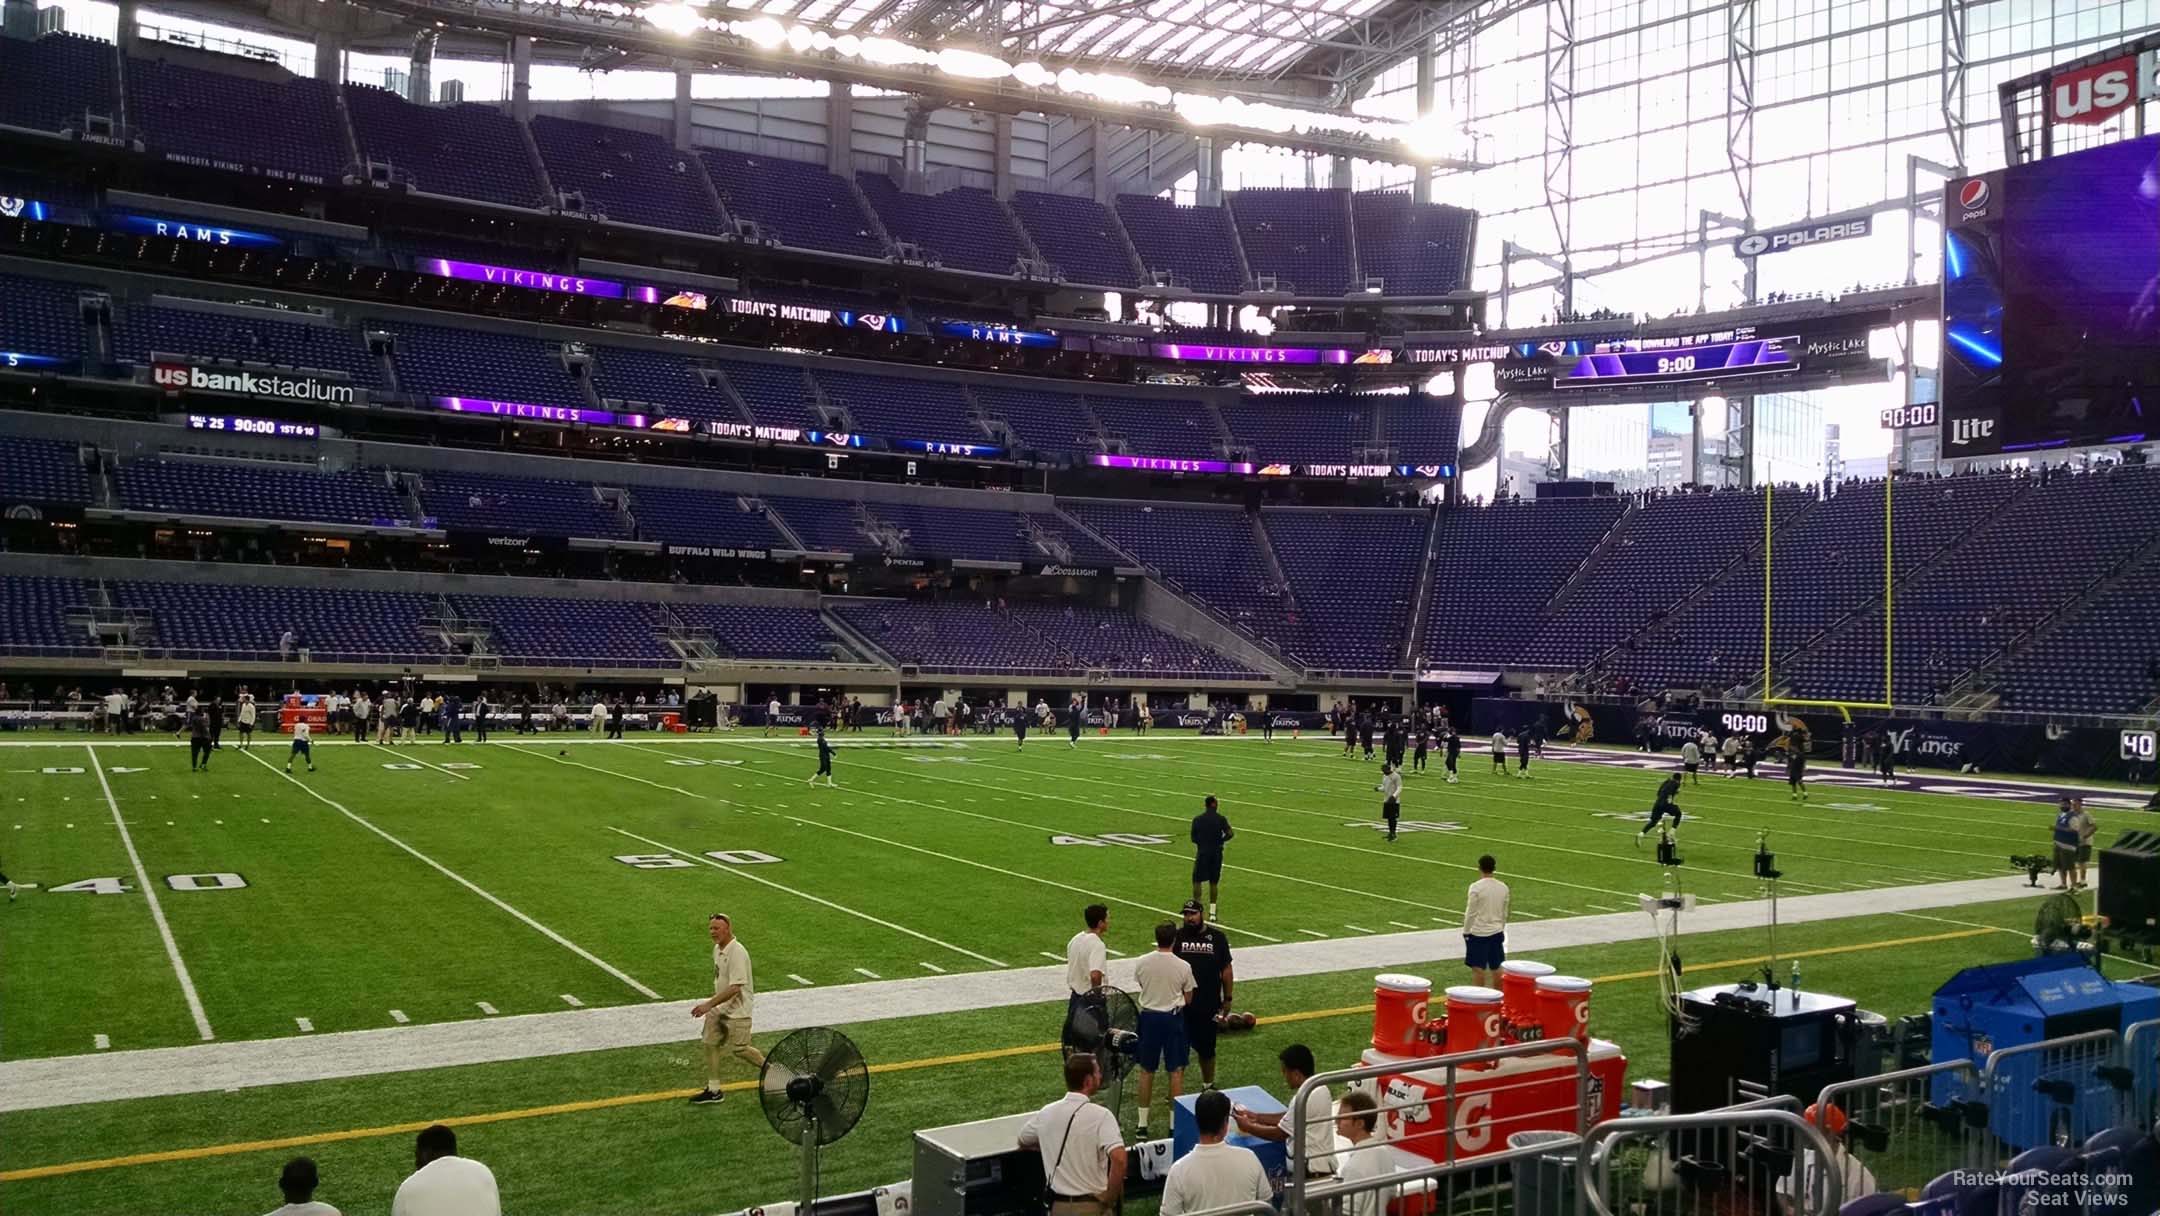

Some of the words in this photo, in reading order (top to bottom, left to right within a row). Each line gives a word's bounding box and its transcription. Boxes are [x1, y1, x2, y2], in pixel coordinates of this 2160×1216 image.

[2055, 70, 2129, 118] us
[213, 160, 244, 172] VIKINGS
[1962, 208, 1987, 221] pepsi
[156, 222, 231, 245] RAMS
[1772, 220, 1866, 248] POLARIS
[484, 268, 585, 292] VIKINGS
[731, 298, 777, 317] TODAY'S
[781, 305, 831, 323] MATCHUP
[972, 328, 1022, 345] RAMS
[1206, 347, 1286, 361] VIKINGS
[1415, 349, 1458, 362] TODAY'S
[1462, 346, 1510, 361] MATCHUP
[1658, 355, 1695, 373] 9:00
[491, 402, 579, 421] VIKINGS
[1882, 405, 1935, 427] 90:00
[209, 418, 225, 430] 25
[234, 419, 275, 433] 90:00
[280, 425, 295, 434] 1ST
[304, 427, 314, 436] 10
[711, 422, 751, 437] TODAY'S
[755, 426, 800, 442] MATCHUP
[1951, 418, 1995, 445] Lite
[926, 442, 972, 456] RAMS
[1131, 458, 1200, 471] VIKINGS
[1309, 464, 1347, 476] TODAY'S
[1350, 465, 1392, 477] MATCHUP
[488, 537, 527, 547] verizon
[668, 545, 709, 556] BUFFALO
[712, 547, 735, 557] WILD
[738, 550, 766, 560] WINGS
[1722, 713, 1768, 733] 90:00
[2124, 734, 2153, 756] 40
[1181, 942, 1214, 952] RAMS
[1455, 1092, 1492, 1151] G
